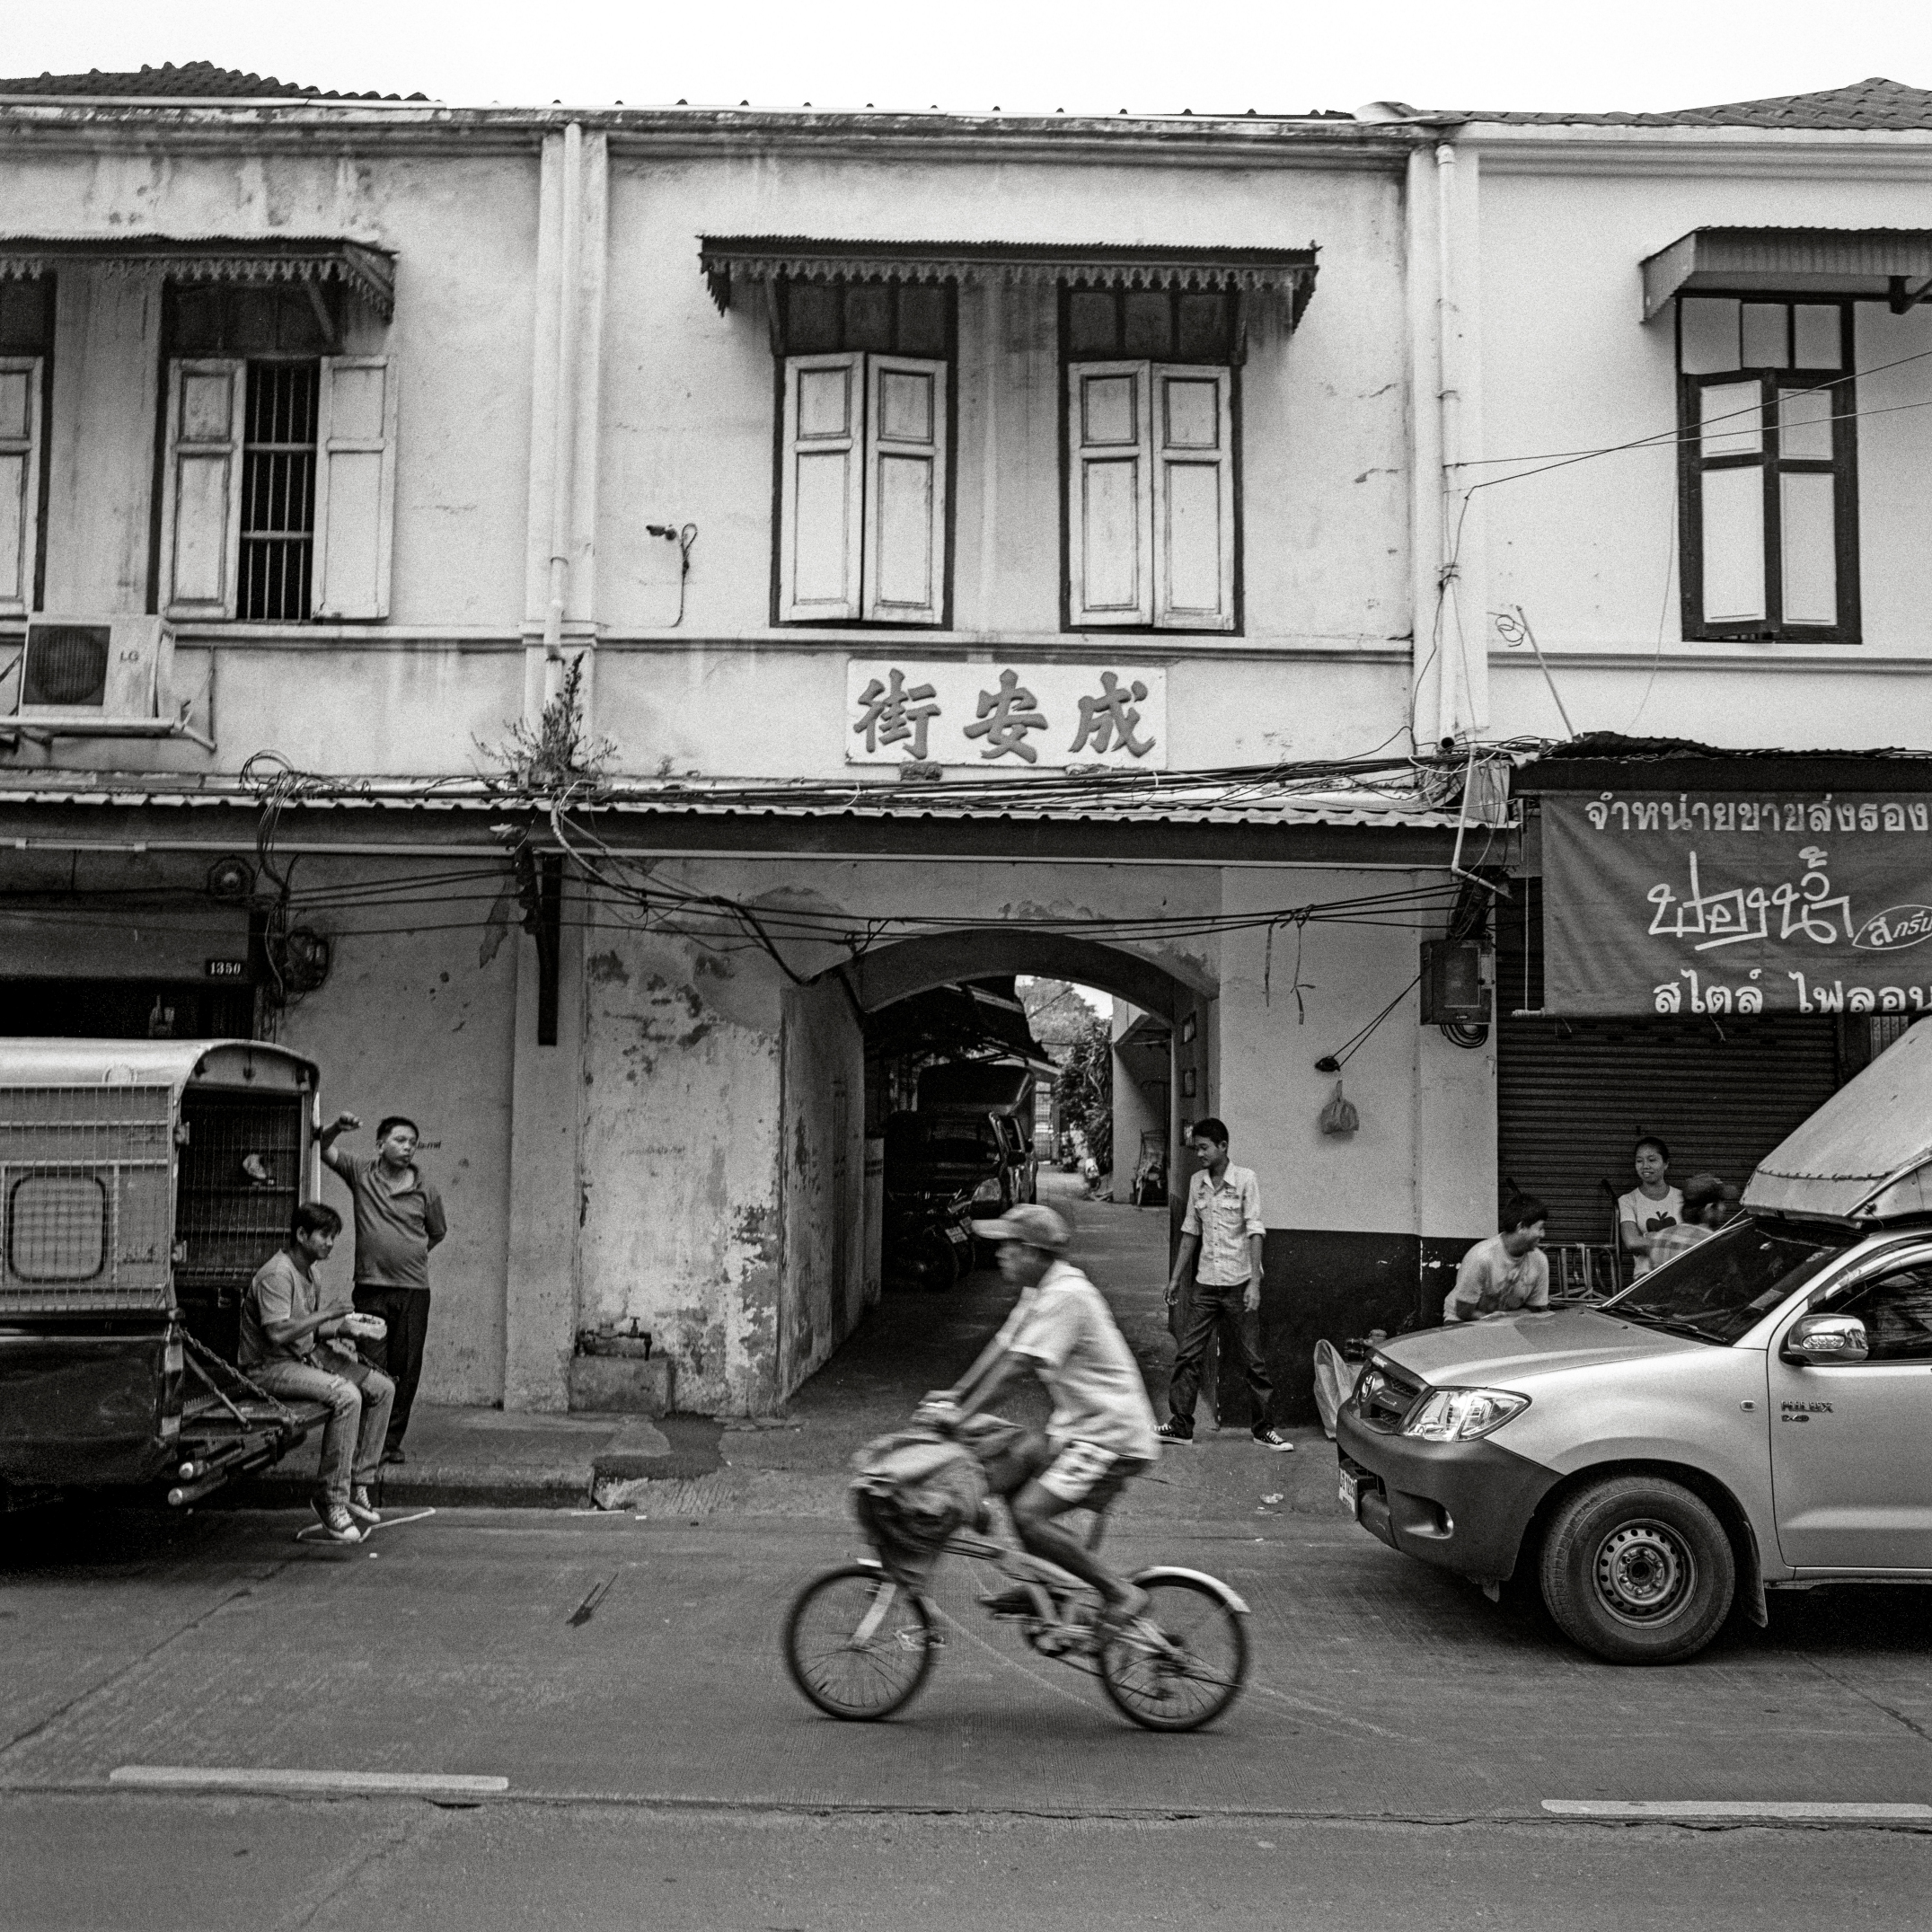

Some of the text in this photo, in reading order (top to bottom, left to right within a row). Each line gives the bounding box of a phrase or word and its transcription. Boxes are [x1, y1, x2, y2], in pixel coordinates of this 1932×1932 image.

[119, 650, 139, 663] LG
[210, 961, 241, 975] 1350
[1653, 969, 1763, 1014] สไตล์
